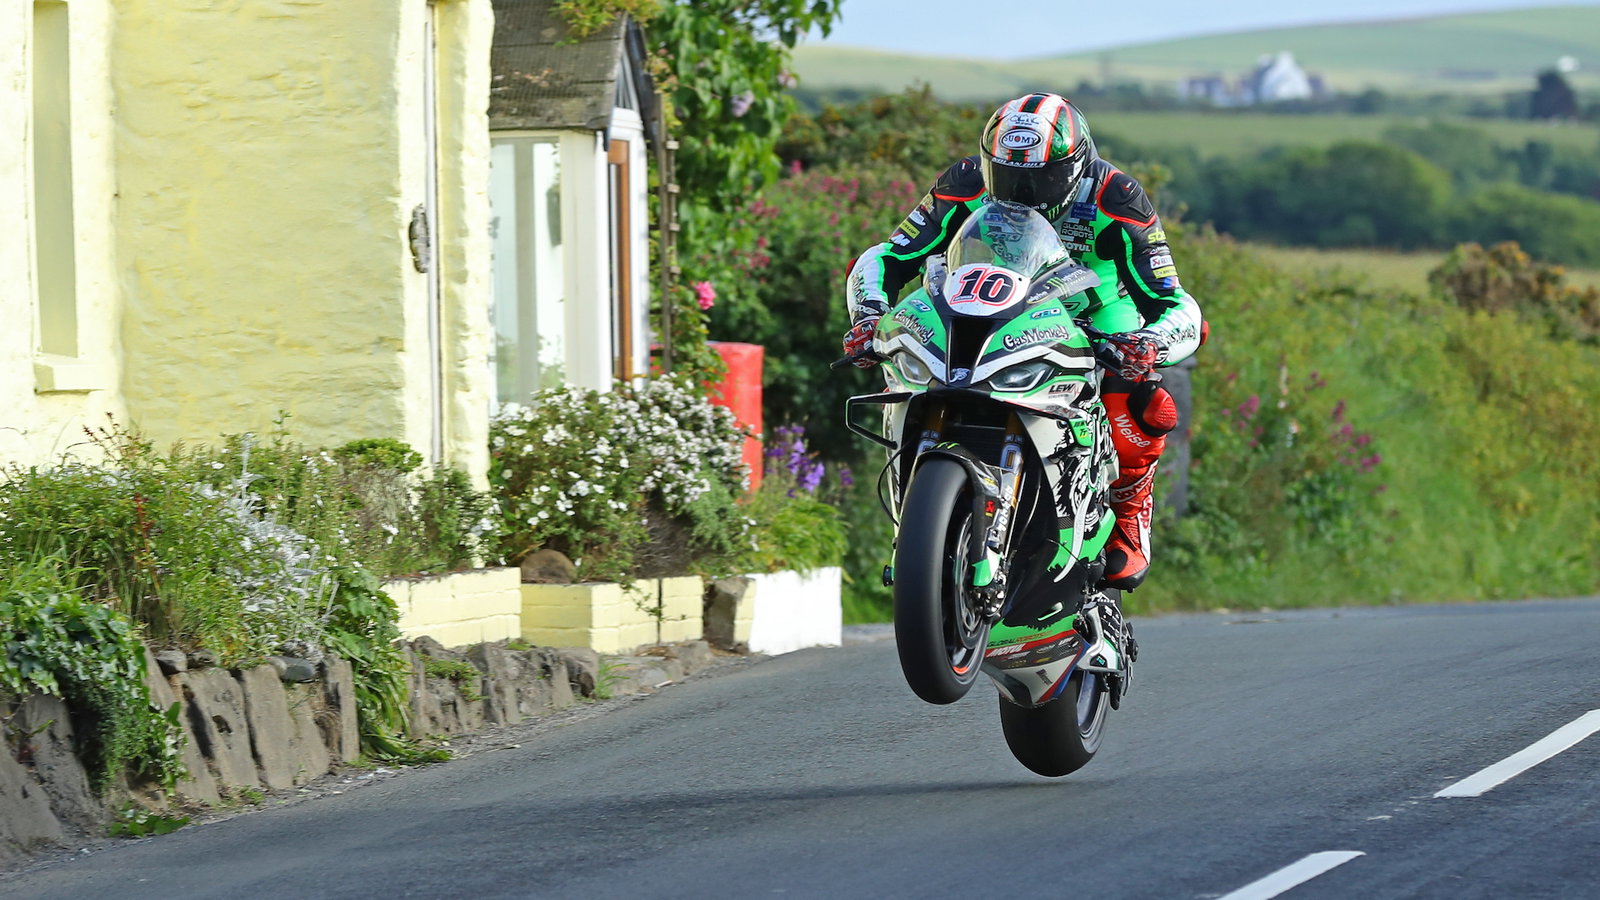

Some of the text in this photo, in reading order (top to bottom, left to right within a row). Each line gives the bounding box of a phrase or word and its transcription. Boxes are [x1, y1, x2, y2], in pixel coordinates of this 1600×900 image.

[1003, 134, 1038, 144] SUOMY
[1062, 222, 1093, 233] GLOBAL
[1061, 228, 1094, 240] ROBOTS
[1063, 241, 1092, 252] OTUL
[949, 267, 1016, 306] 10
[1049, 383, 1075, 393] LEW
[1114, 413, 1152, 448] Weise
